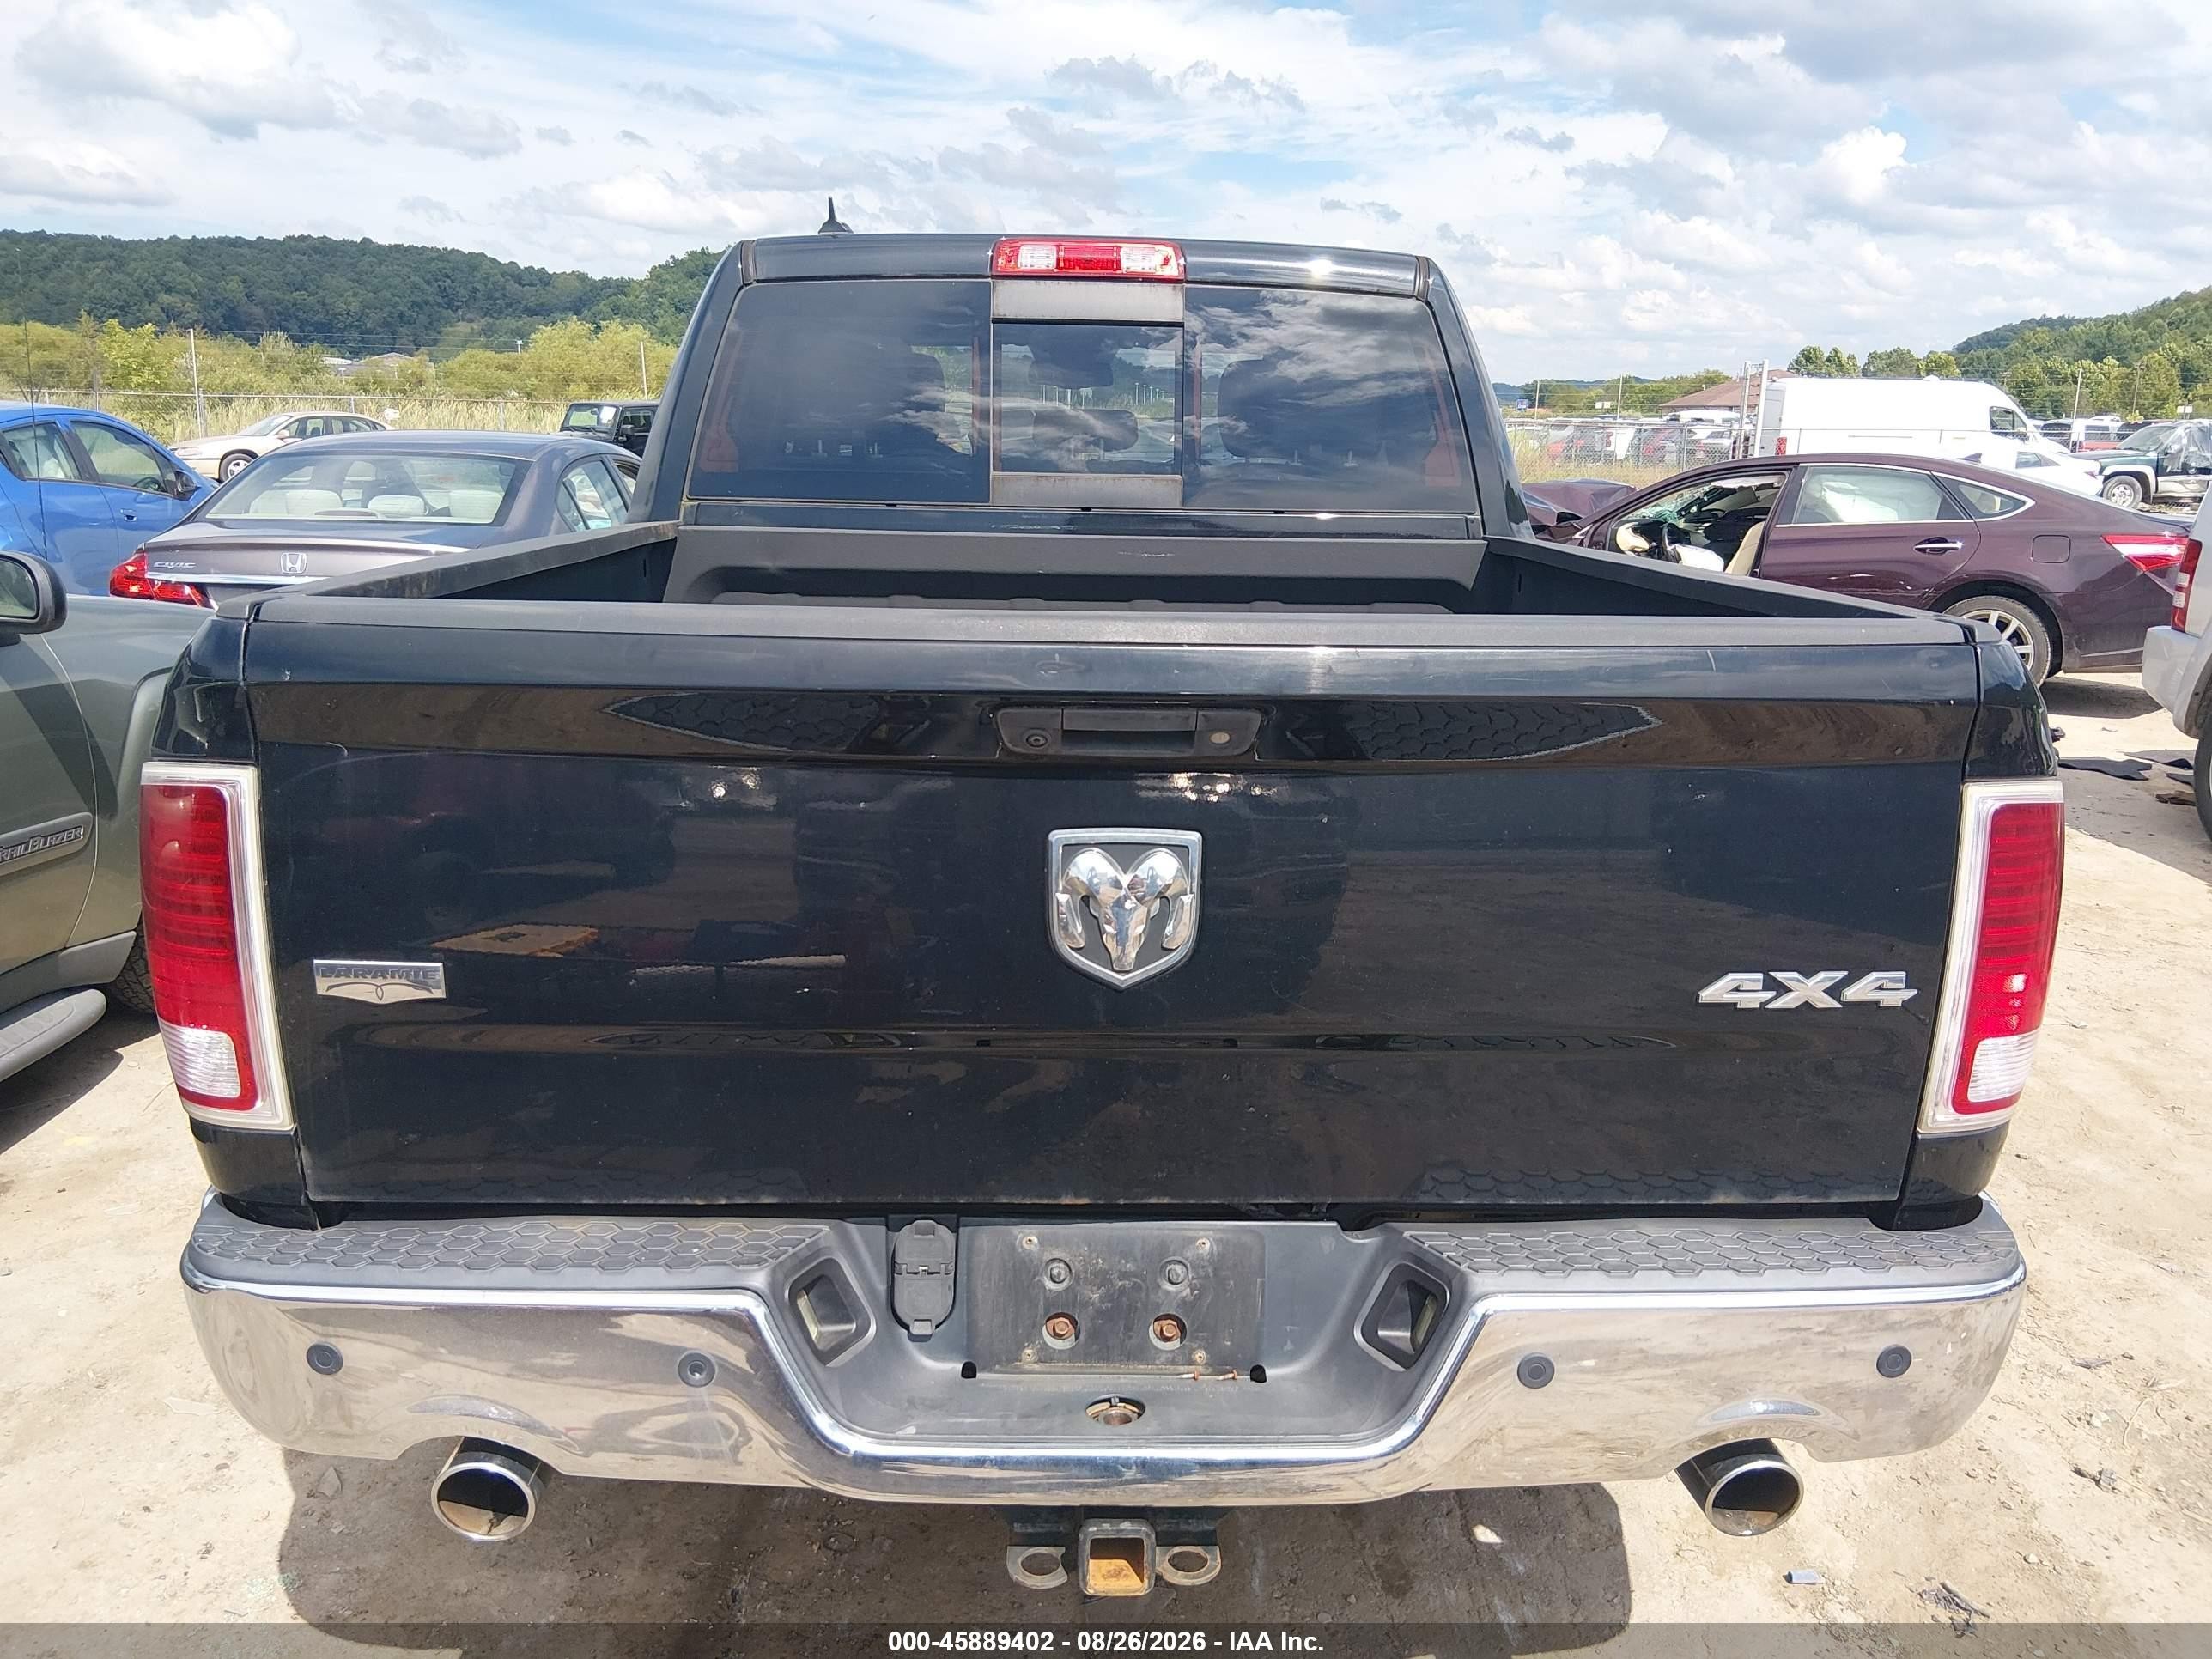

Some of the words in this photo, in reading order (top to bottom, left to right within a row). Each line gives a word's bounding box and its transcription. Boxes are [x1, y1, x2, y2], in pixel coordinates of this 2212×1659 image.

[0, 825, 83, 863] RAILBLAZER
[319, 967, 440, 981] LARAMIE
[1698, 971, 1918, 1008] 4X4
